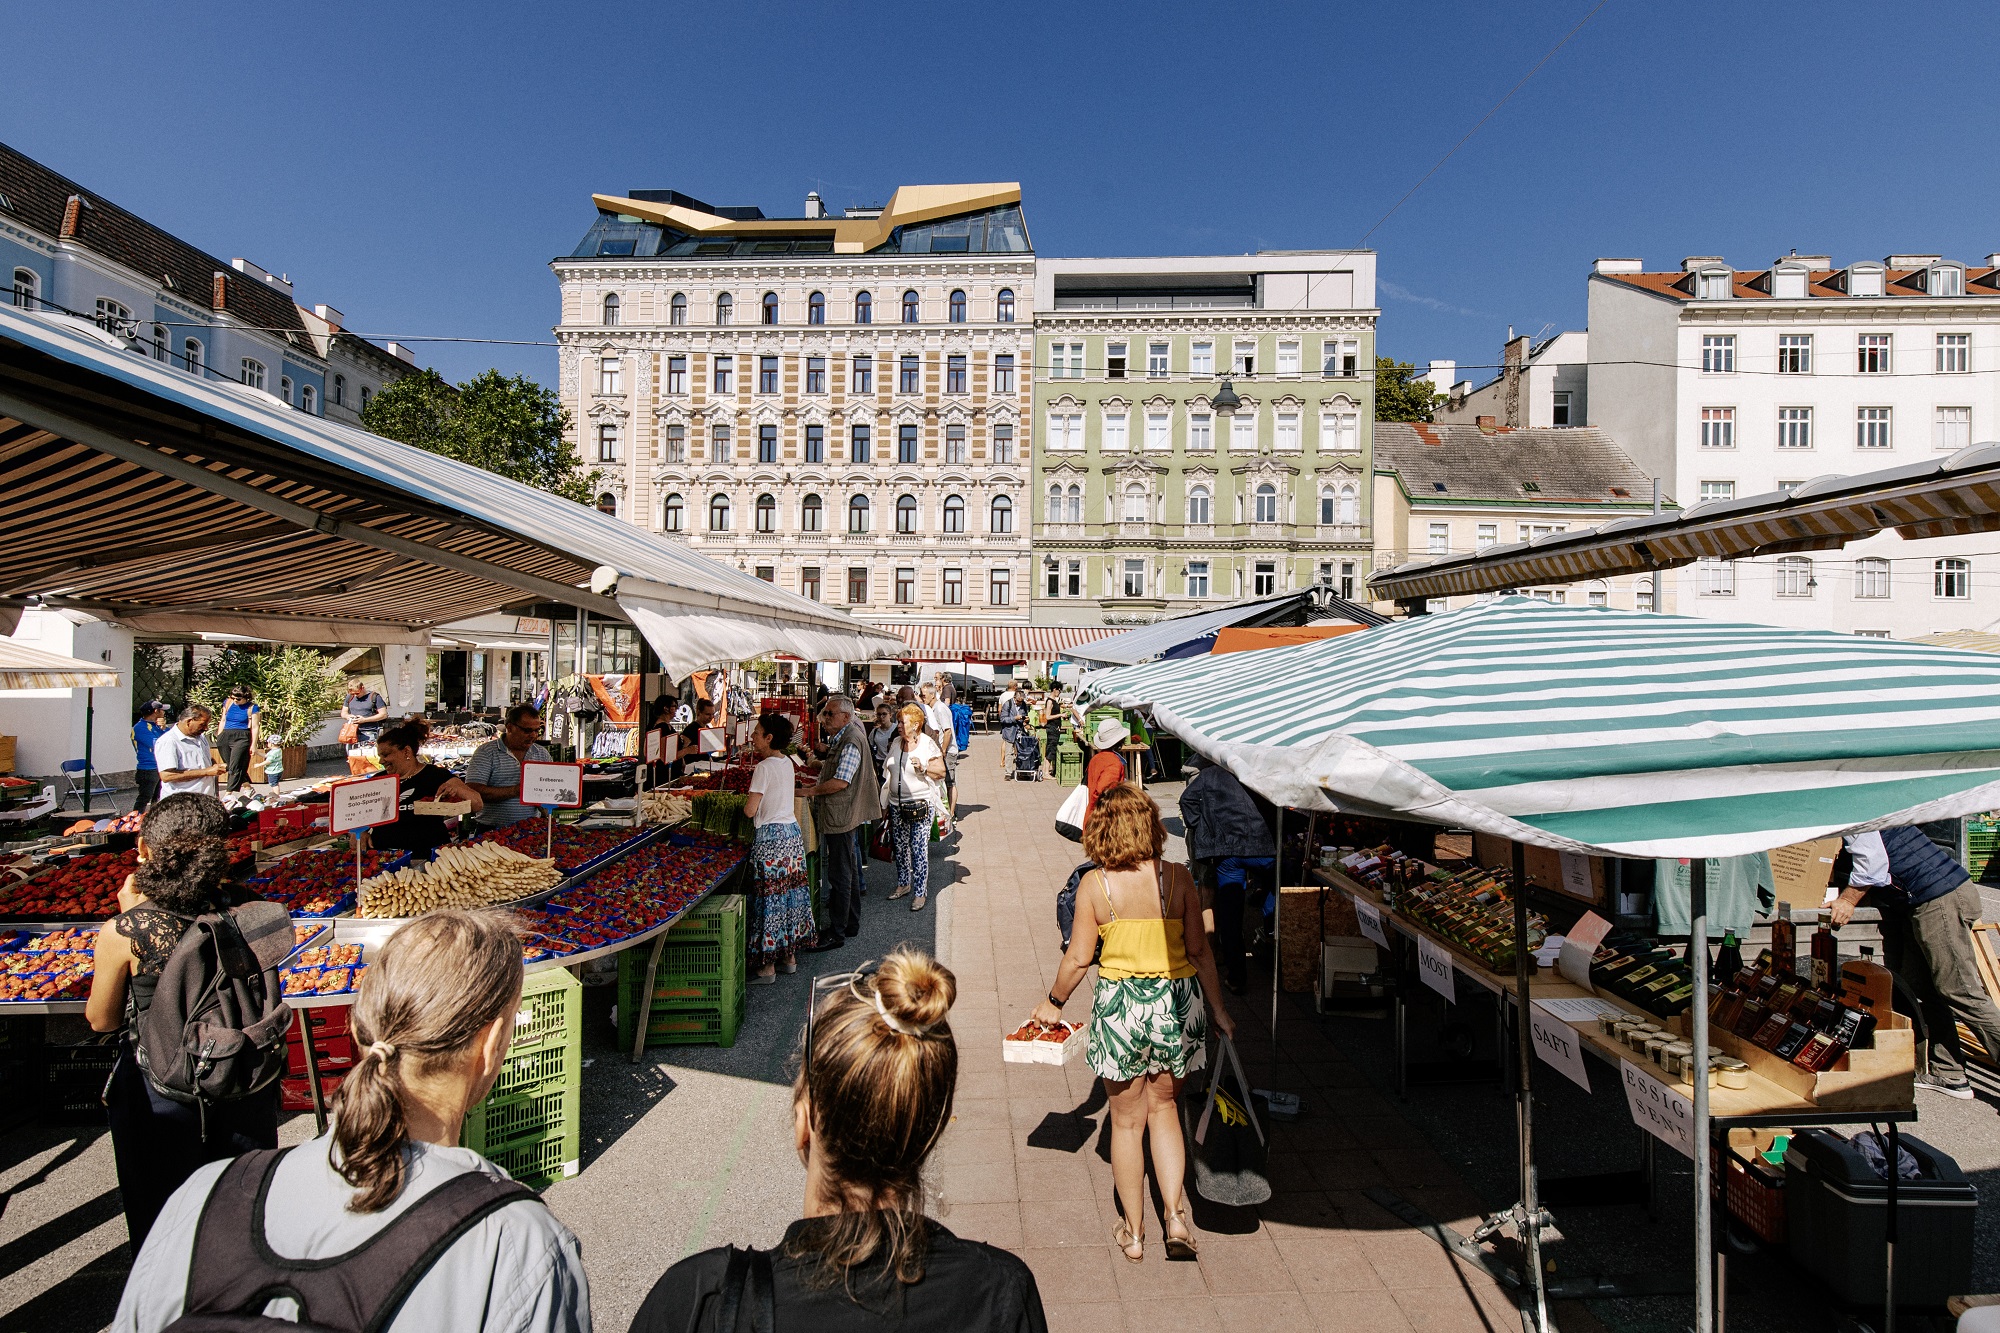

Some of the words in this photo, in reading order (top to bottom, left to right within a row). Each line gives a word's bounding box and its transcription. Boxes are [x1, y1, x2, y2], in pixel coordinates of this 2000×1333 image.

[347, 797, 383, 808] Solo-Spargel
[349, 791, 381, 801] Marchfelder
[1358, 910, 1381, 933] CIDER
[1420, 950, 1449, 980] MOST
[1533, 1023, 1571, 1060] SAFT
[1625, 1068, 1685, 1119] ESSIG
[1635, 1099, 1687, 1143] SENF
